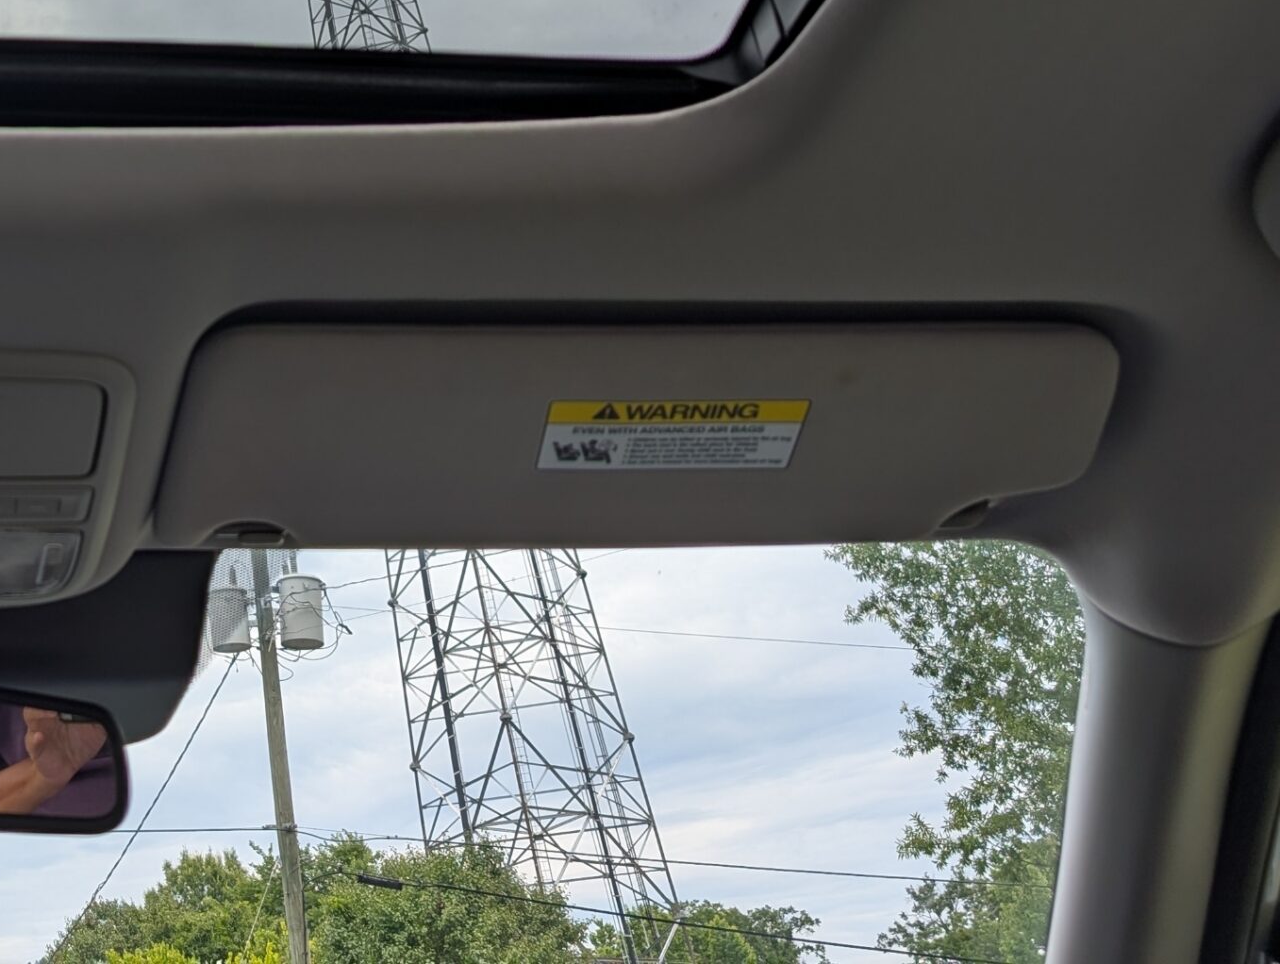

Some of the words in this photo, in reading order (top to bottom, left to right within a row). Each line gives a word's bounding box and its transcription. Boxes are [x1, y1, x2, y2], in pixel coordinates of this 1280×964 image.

[626, 403, 760, 420] WARNING
[572, 426, 605, 435] EVEN
[608, 426, 637, 434] WITH
[640, 426, 706, 434] ADVANCED
[708, 425, 728, 434] AIR
[730, 425, 765, 434] BAGS
